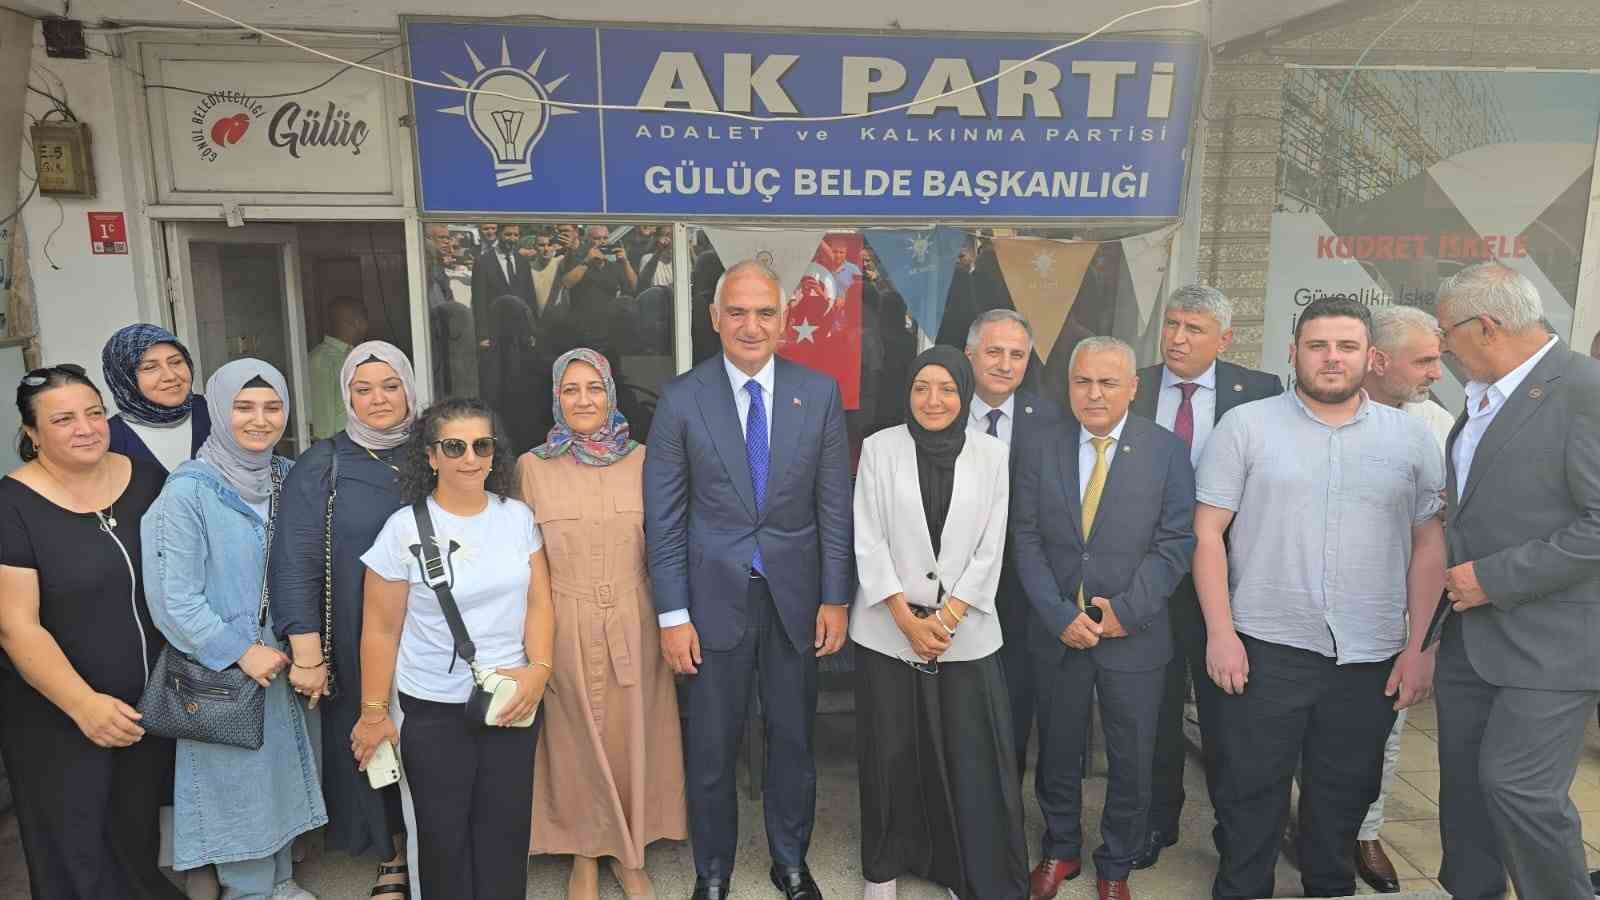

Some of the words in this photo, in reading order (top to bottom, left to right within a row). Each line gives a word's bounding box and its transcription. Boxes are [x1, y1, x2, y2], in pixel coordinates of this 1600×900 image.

[636, 51, 801, 114] AK
[841, 56, 1176, 119] PARTİ
[268, 100, 370, 159] Gülüç
[635, 125, 764, 140] ADALET
[796, 130, 829, 141] ve
[860, 127, 1026, 142] KALKINMA
[1045, 125, 1168, 142] PARTİSİ
[644, 160, 781, 203] GÜLÜÇ
[794, 168, 913, 197] BELDE
[922, 164, 1149, 205] BAŞKANLIĞI
[1317, 235, 1426, 259] KUDRET
